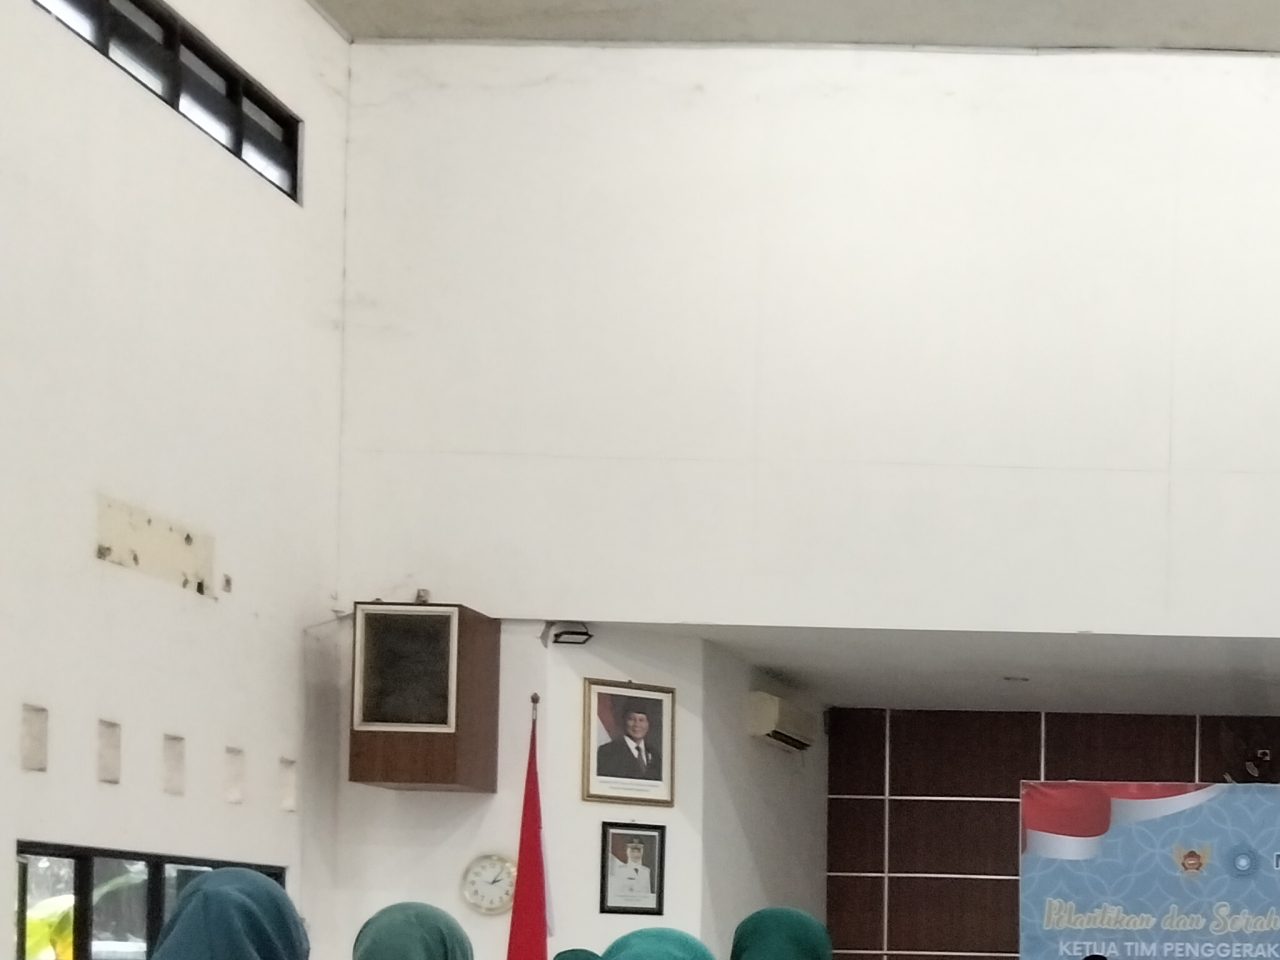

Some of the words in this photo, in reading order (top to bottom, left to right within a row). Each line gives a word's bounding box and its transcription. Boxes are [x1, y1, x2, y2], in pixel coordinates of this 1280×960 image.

[1161, 904, 1206, 930] dan
[1059, 941, 1120, 957] KETUA
[1124, 942, 1157, 957] TIM
[1163, 942, 1280, 958] PENGGERAK
